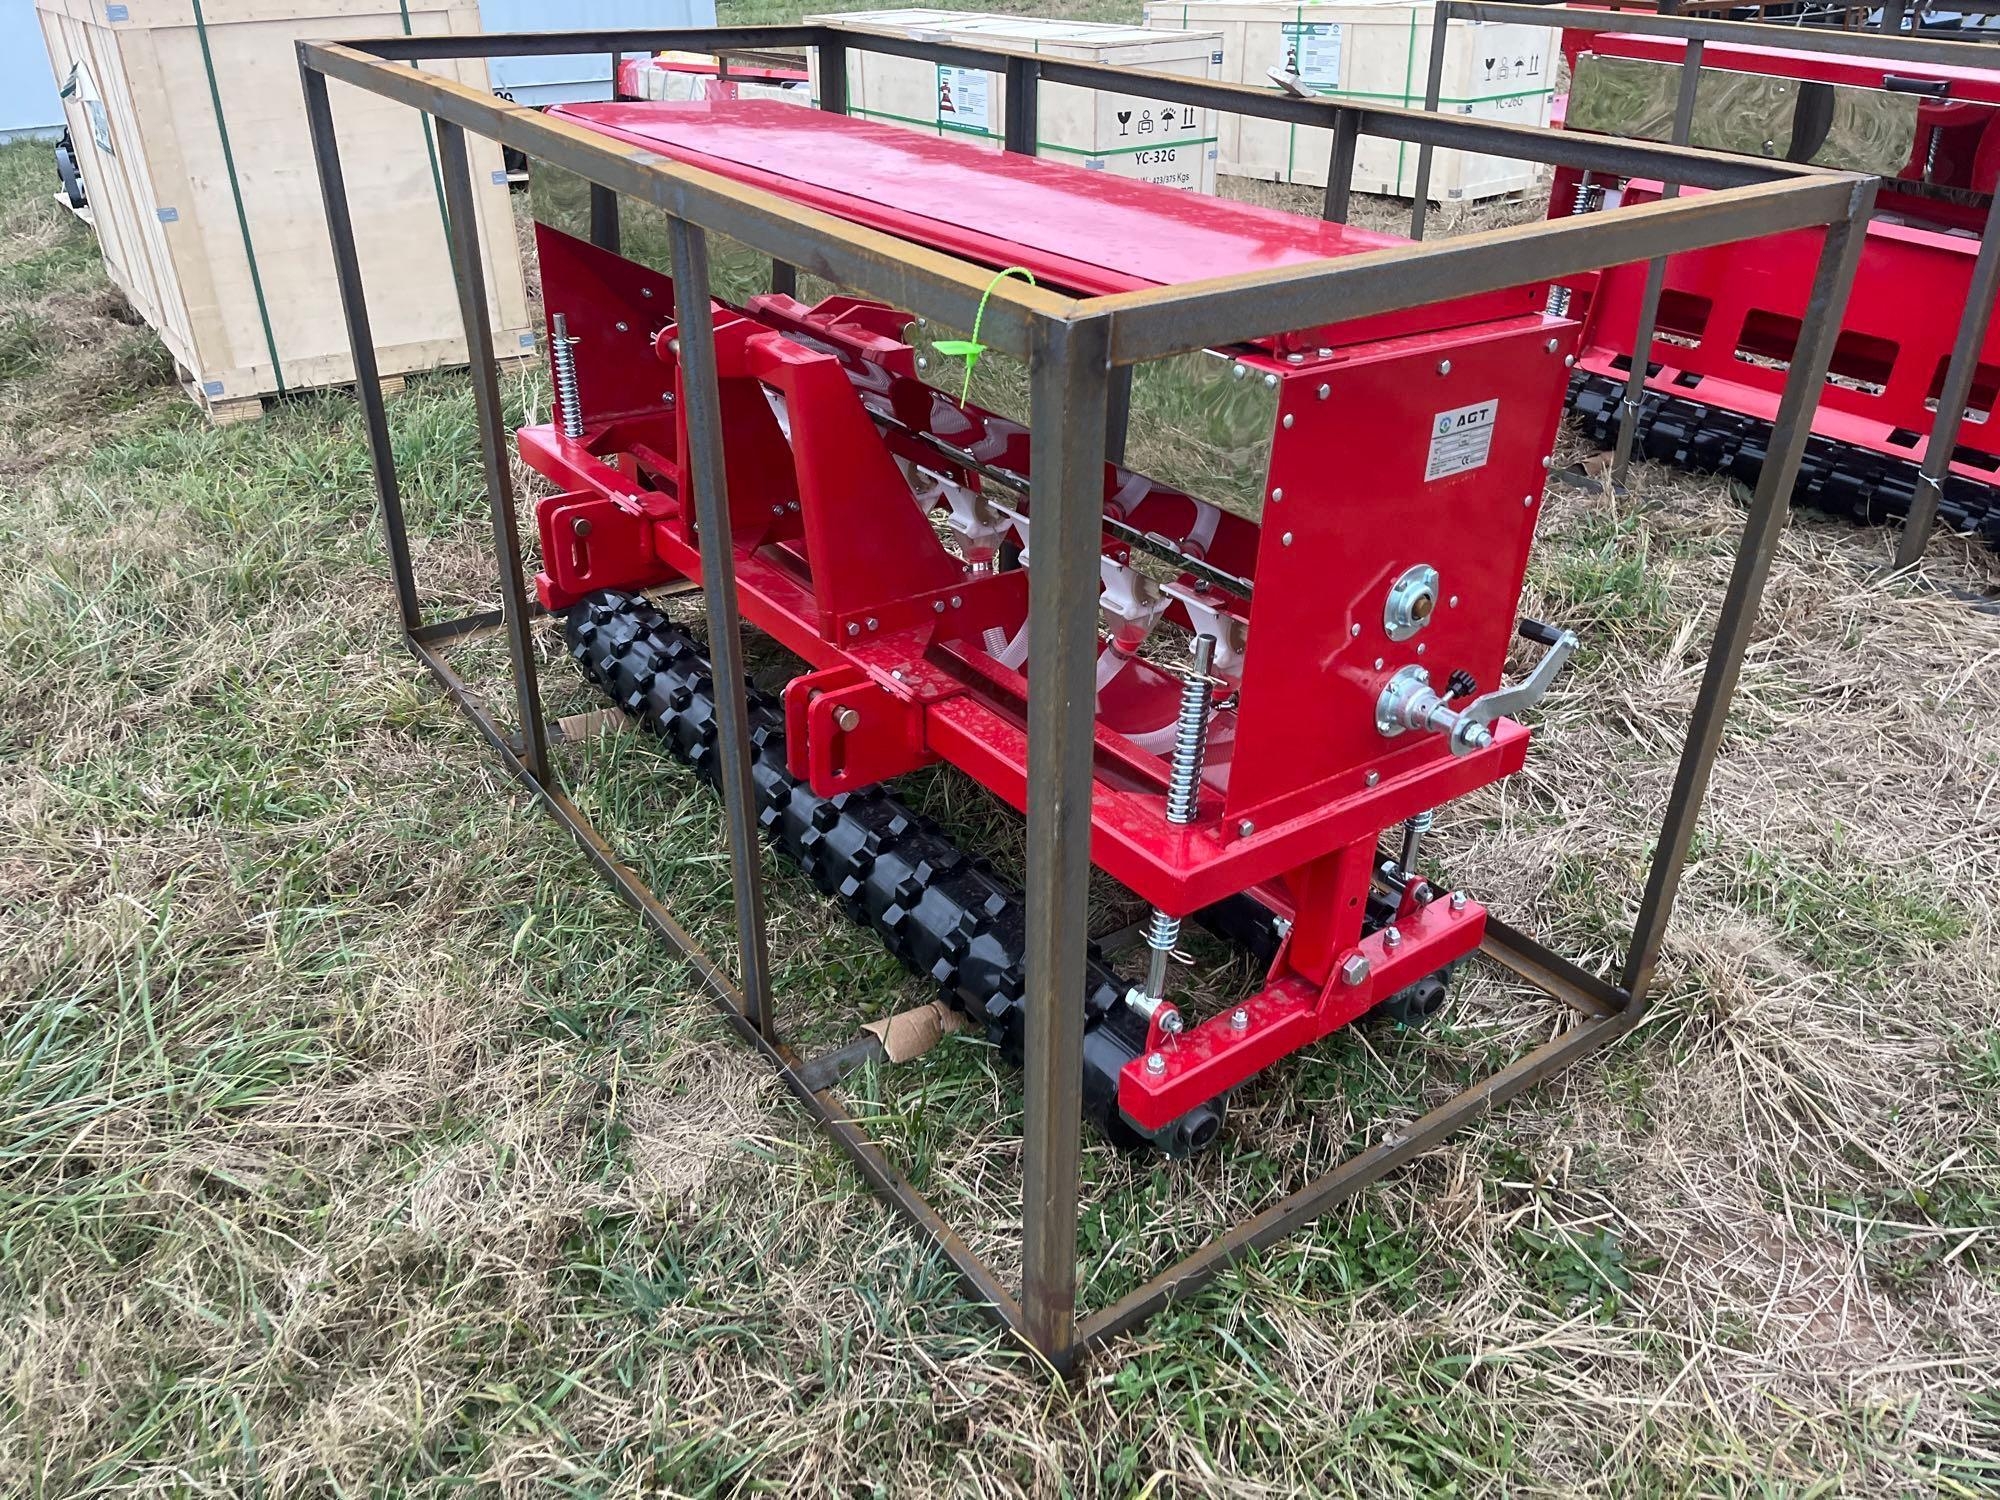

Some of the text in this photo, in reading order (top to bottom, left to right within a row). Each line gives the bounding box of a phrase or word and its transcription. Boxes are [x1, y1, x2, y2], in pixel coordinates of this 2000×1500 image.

[1135, 149, 1176, 165] YC-32G
[1177, 172, 1190, 183] Kgs
[1457, 409, 1489, 427] AGT
